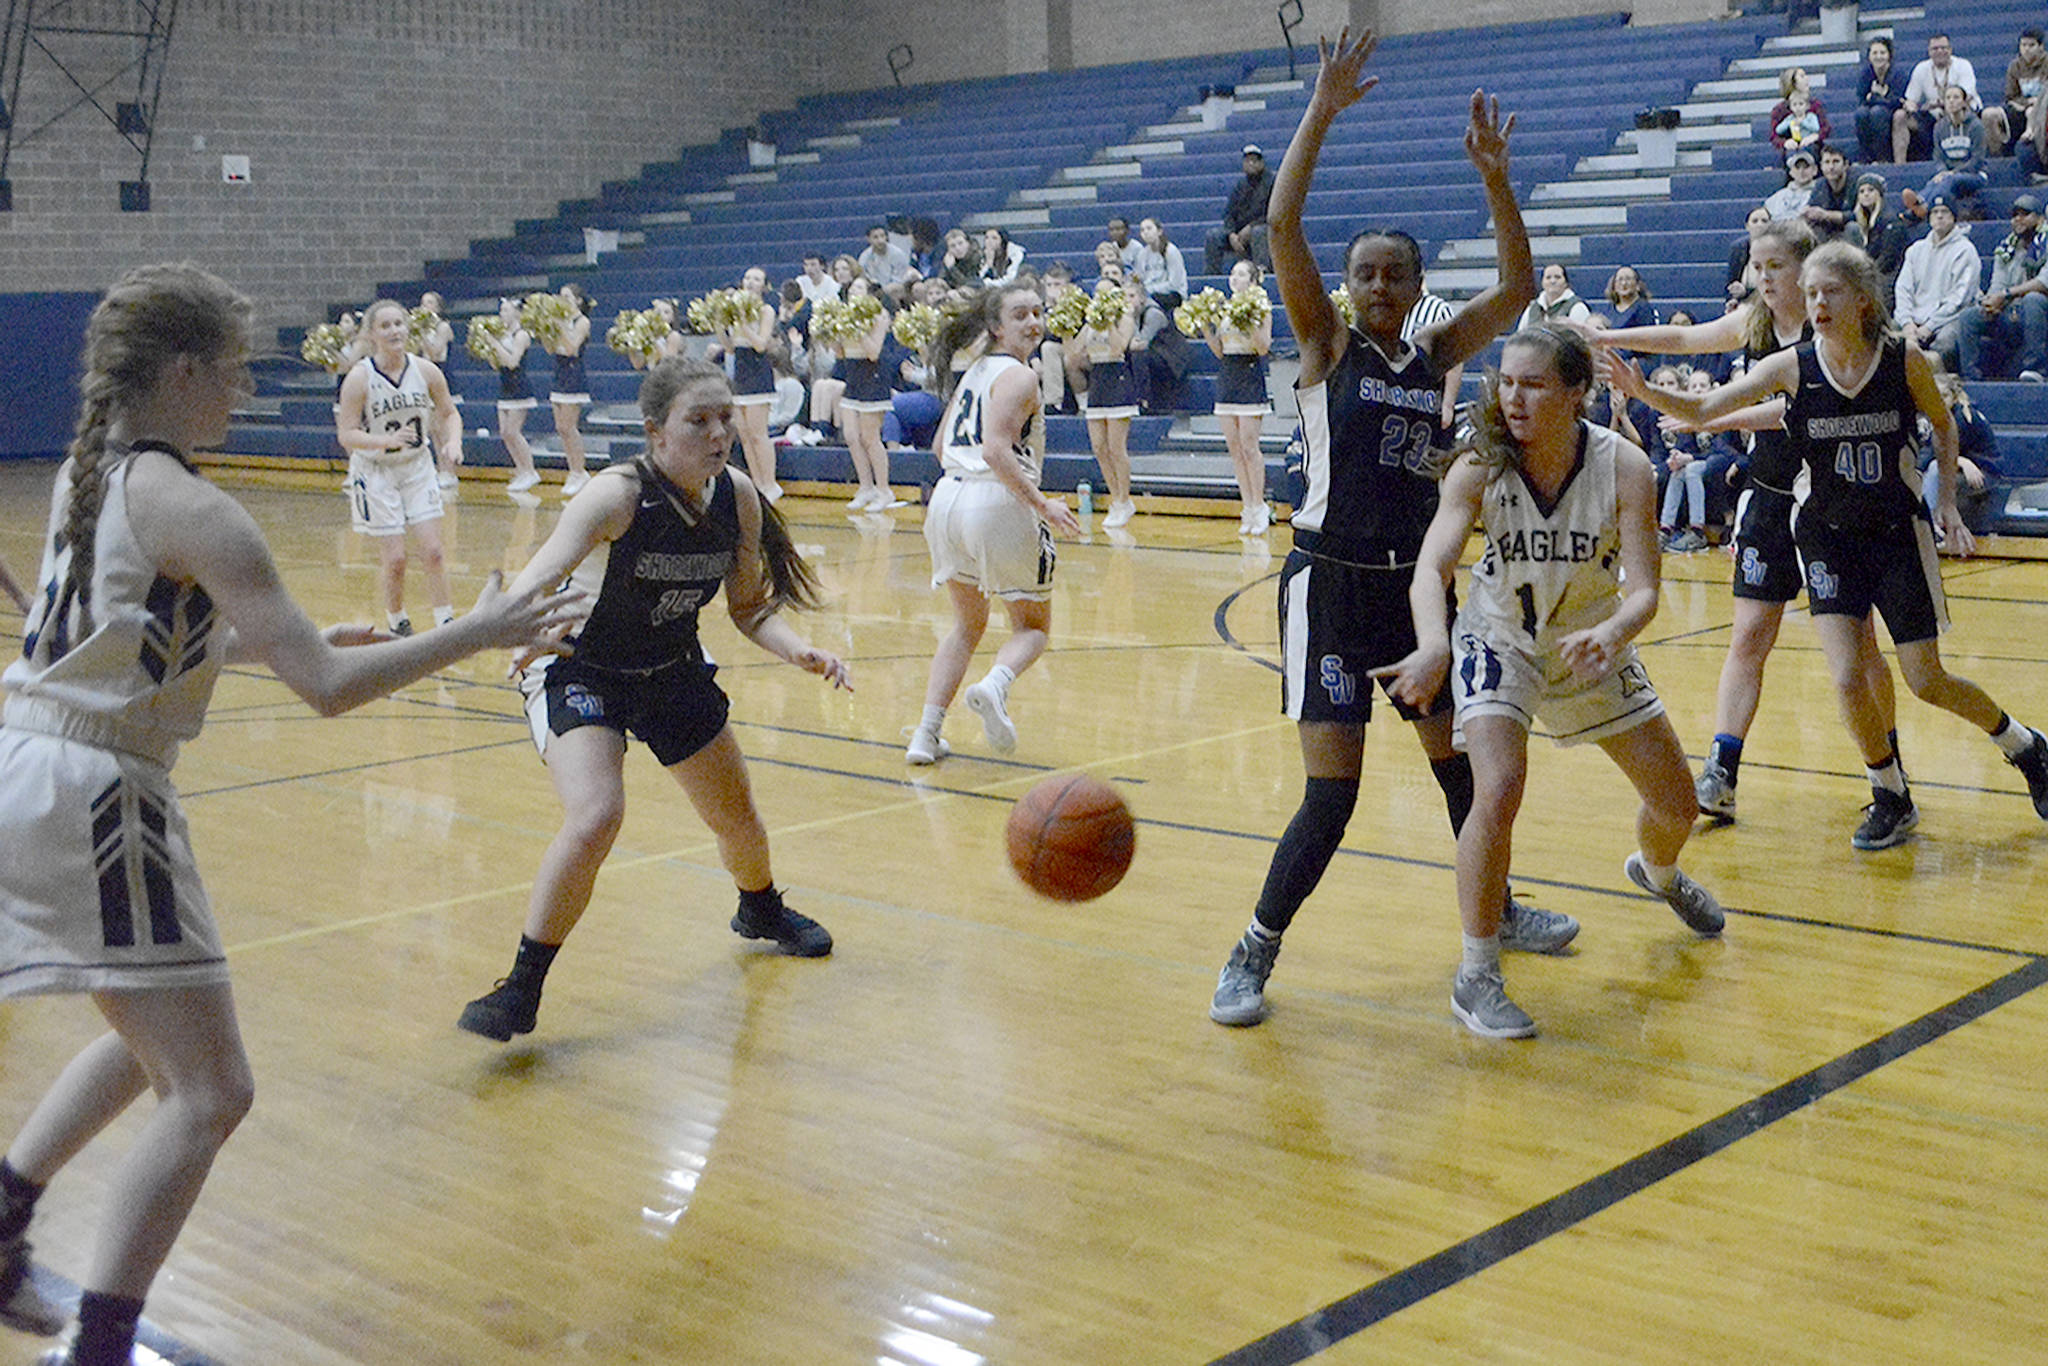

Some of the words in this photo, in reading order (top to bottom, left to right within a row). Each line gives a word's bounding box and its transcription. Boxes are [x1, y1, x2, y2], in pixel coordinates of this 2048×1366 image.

[950, 388, 983, 447] 21
[1807, 411, 1900, 439] SHOREWOOD
[1379, 414, 1433, 472] 23
[1834, 441, 1882, 484] 40
[1741, 546, 1767, 585] SW
[1809, 561, 1839, 599] SW
[1320, 654, 1355, 705] SW
